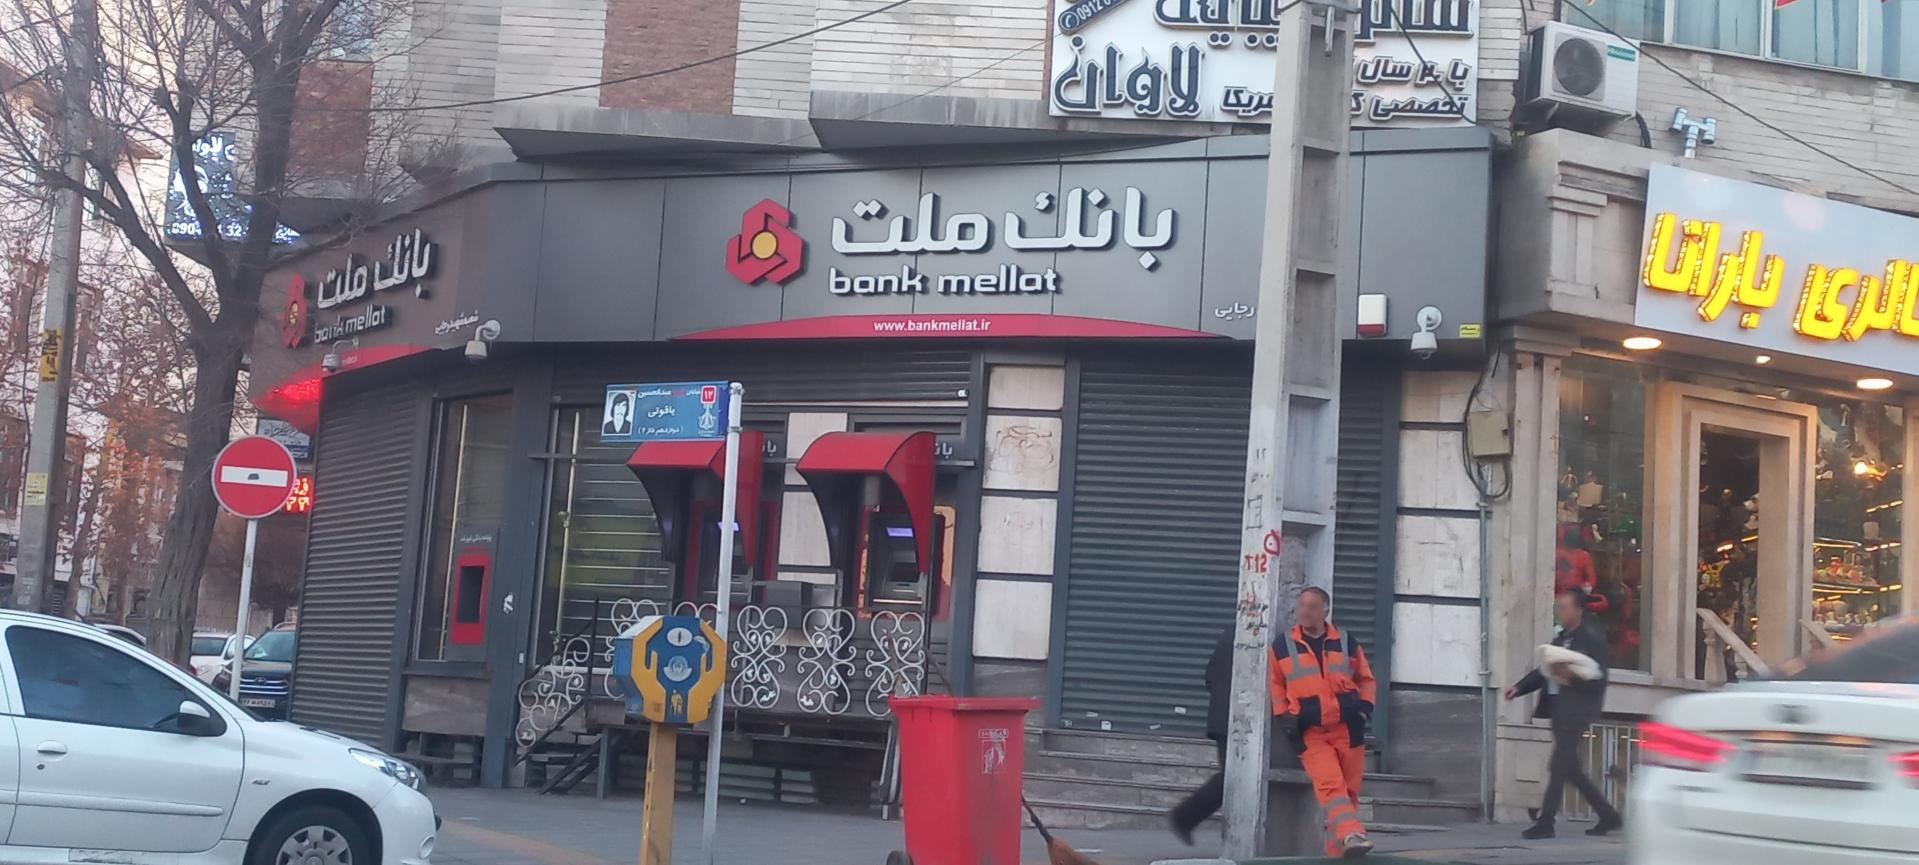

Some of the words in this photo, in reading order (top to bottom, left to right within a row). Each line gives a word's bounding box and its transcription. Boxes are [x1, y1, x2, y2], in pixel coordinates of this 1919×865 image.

[1054, 34, 1203, 114] لاوان
[1359, 57, 1413, 81] سال
[1450, 60, 1470, 86] با
[830, 192, 992, 255] ملت
[317, 252, 368, 309] ملت
[828, 266, 924, 295] bank
[937, 263, 1059, 294] mellat
[1214, 301, 1255, 320] رجایی
[1793, 259, 1919, 342] الری
[313, 314, 345, 344] bank
[345, 304, 387, 333] mellat
[874, 319, 991, 333] www.bankmellat.ir
[647, 404, 676, 418] یاقوتی
